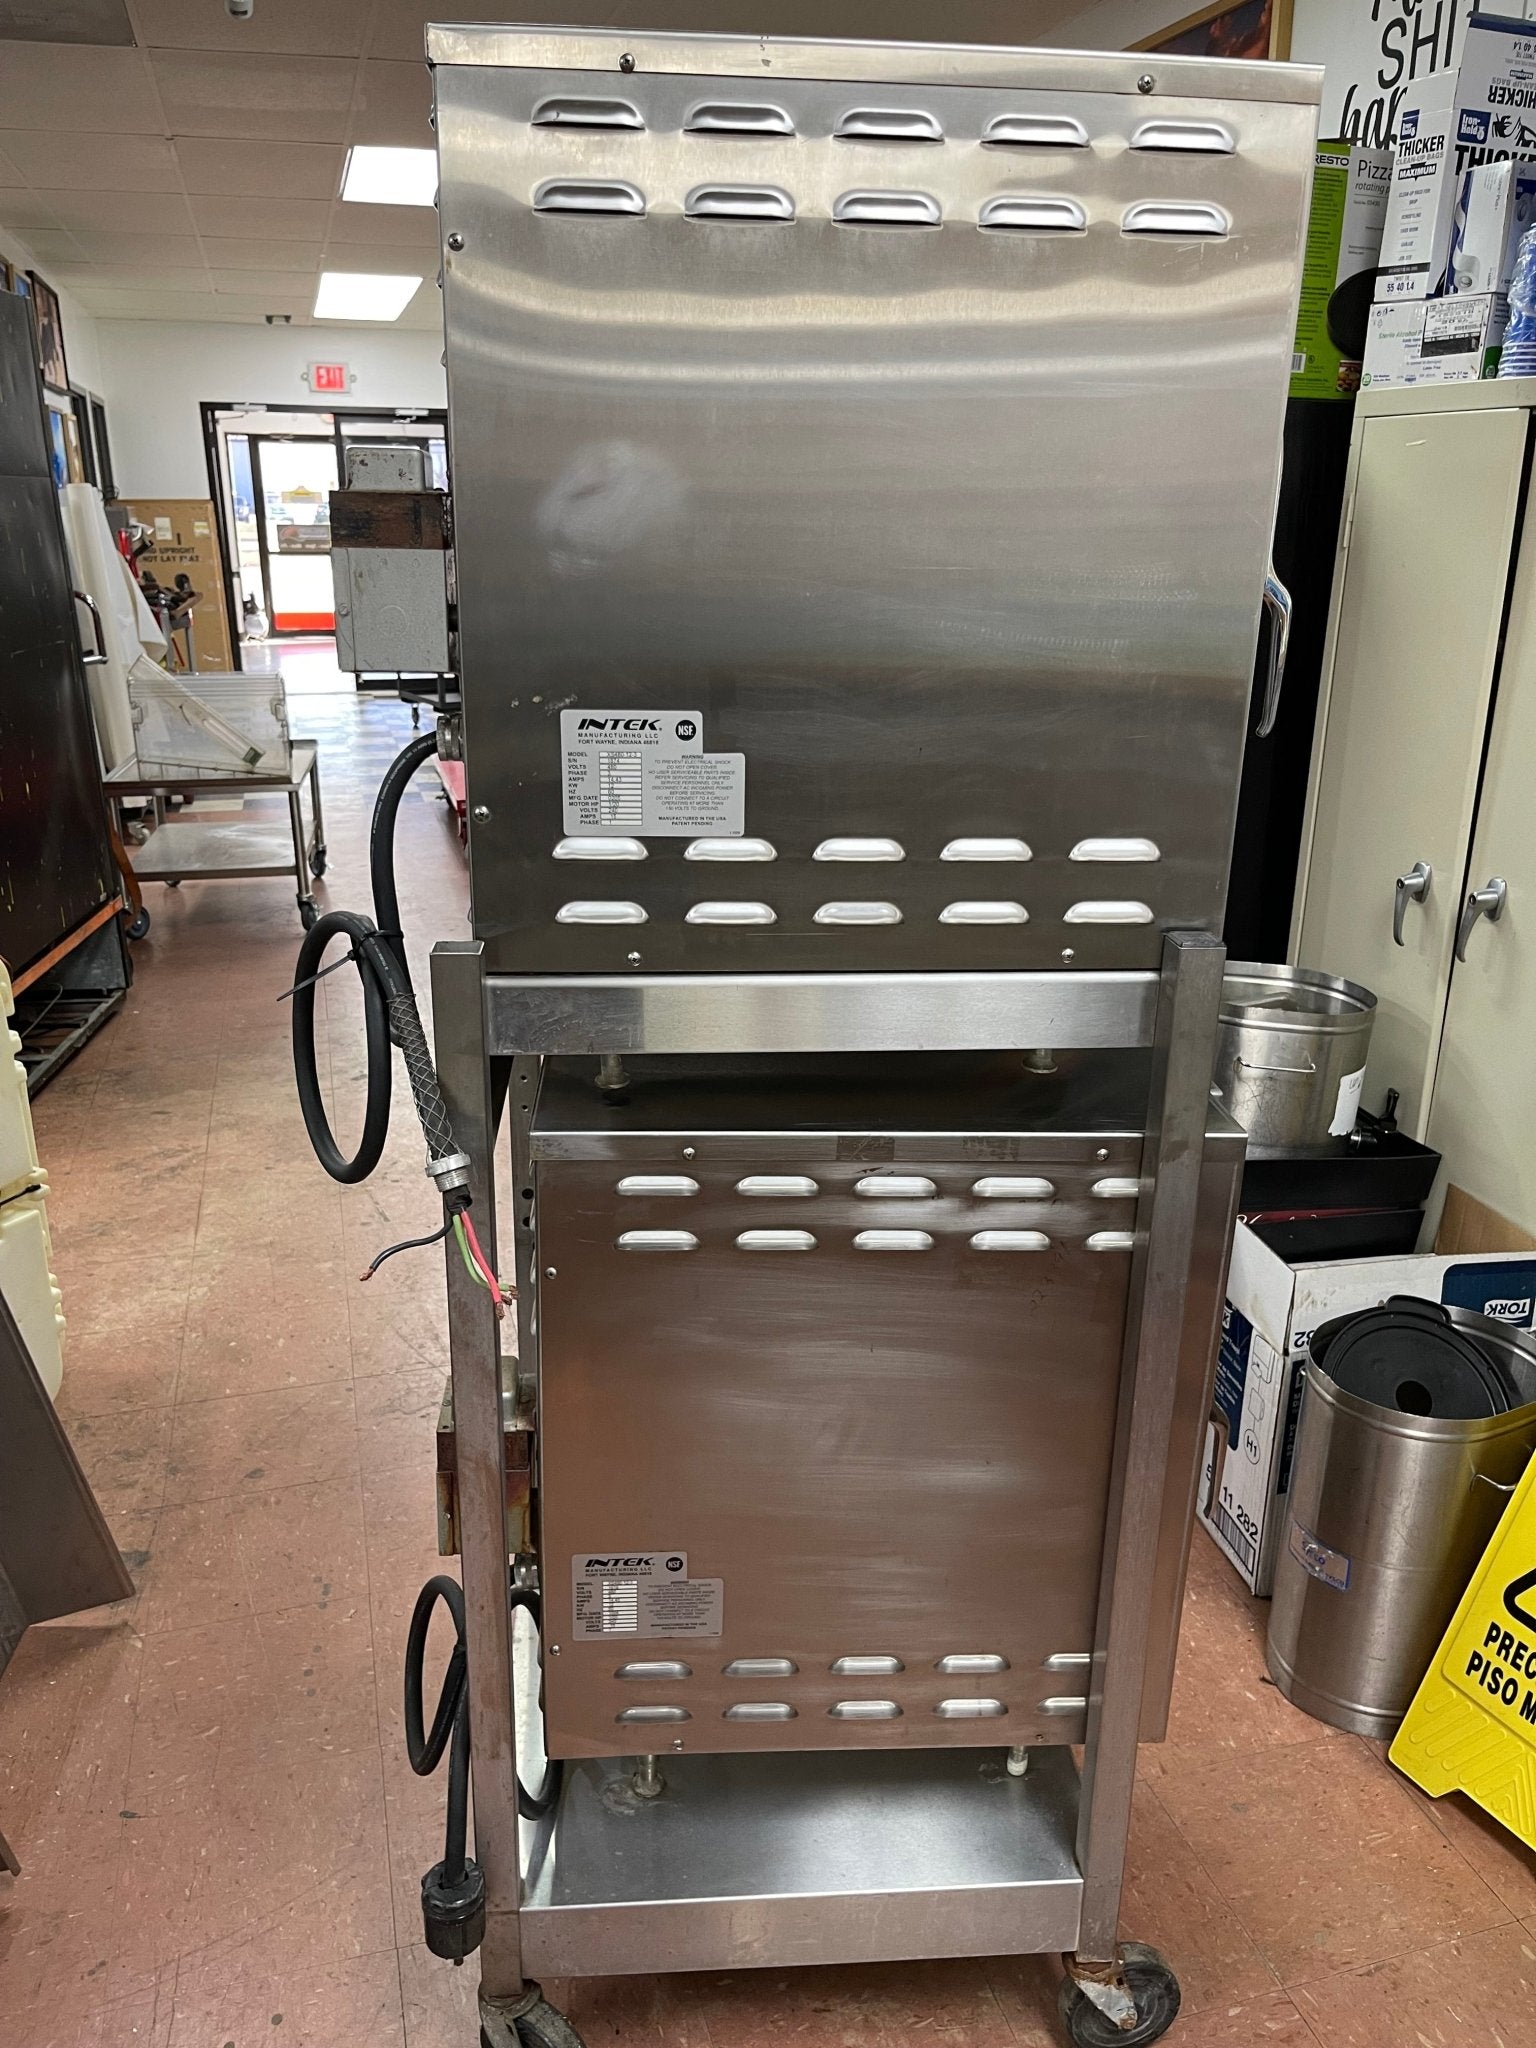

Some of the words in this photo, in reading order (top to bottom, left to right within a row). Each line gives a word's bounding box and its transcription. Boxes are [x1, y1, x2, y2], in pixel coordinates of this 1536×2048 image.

[1378, 0, 1480, 89] SHI
[1399, 135, 1444, 157] THICKER
[1399, 165, 1436, 178] MAXIMUM
[1355, 182, 1385, 194] rotating
[1387, 283, 1395, 292] 55
[1397, 282, 1404, 291] 40
[578, 719, 660, 730] INTEK
[677, 725, 694, 736] NSF
[1487, 1302, 1527, 1315] TORK
[1246, 1440, 1257, 1457] H1
[1223, 1486, 1233, 1510] 11
[1236, 1504, 1258, 1543] 282
[585, 1557, 653, 1567] INTEK
[1465, 1650, 1519, 1706] PISO
